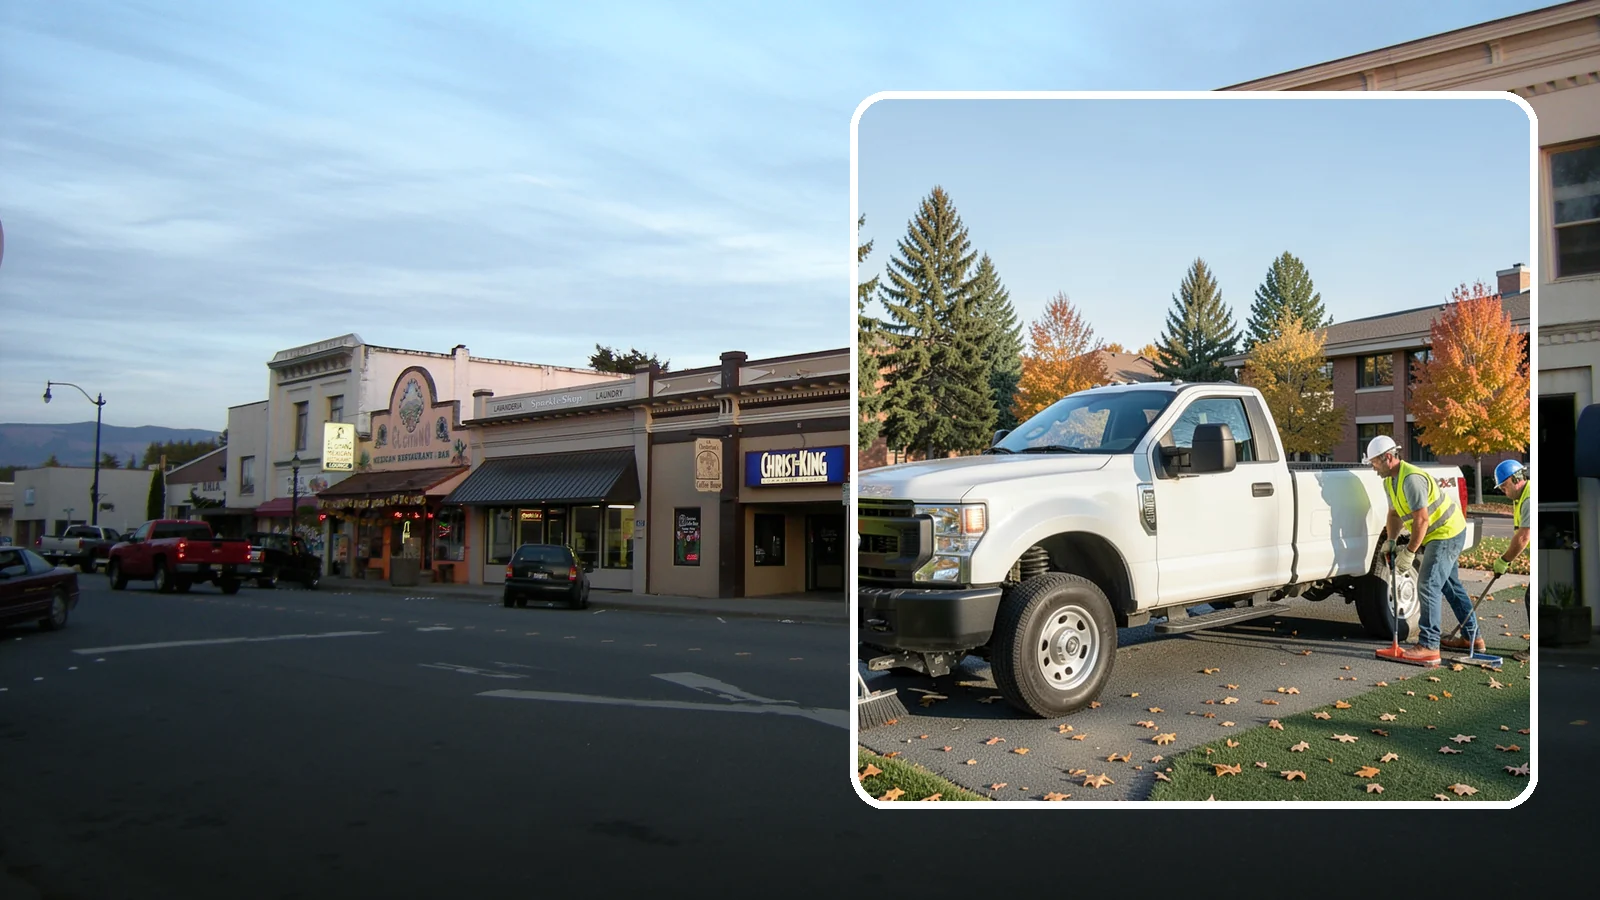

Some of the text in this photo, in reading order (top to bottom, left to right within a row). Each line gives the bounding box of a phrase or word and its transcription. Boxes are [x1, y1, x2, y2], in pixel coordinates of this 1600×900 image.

[493, 389, 623, 413] LAVANDERIA Sparkle Shop LAUNDRY
[373, 455, 396, 464] MEXICAN
[397, 452, 433, 462] RESTAURANT
[438, 450, 450, 459] BAR
